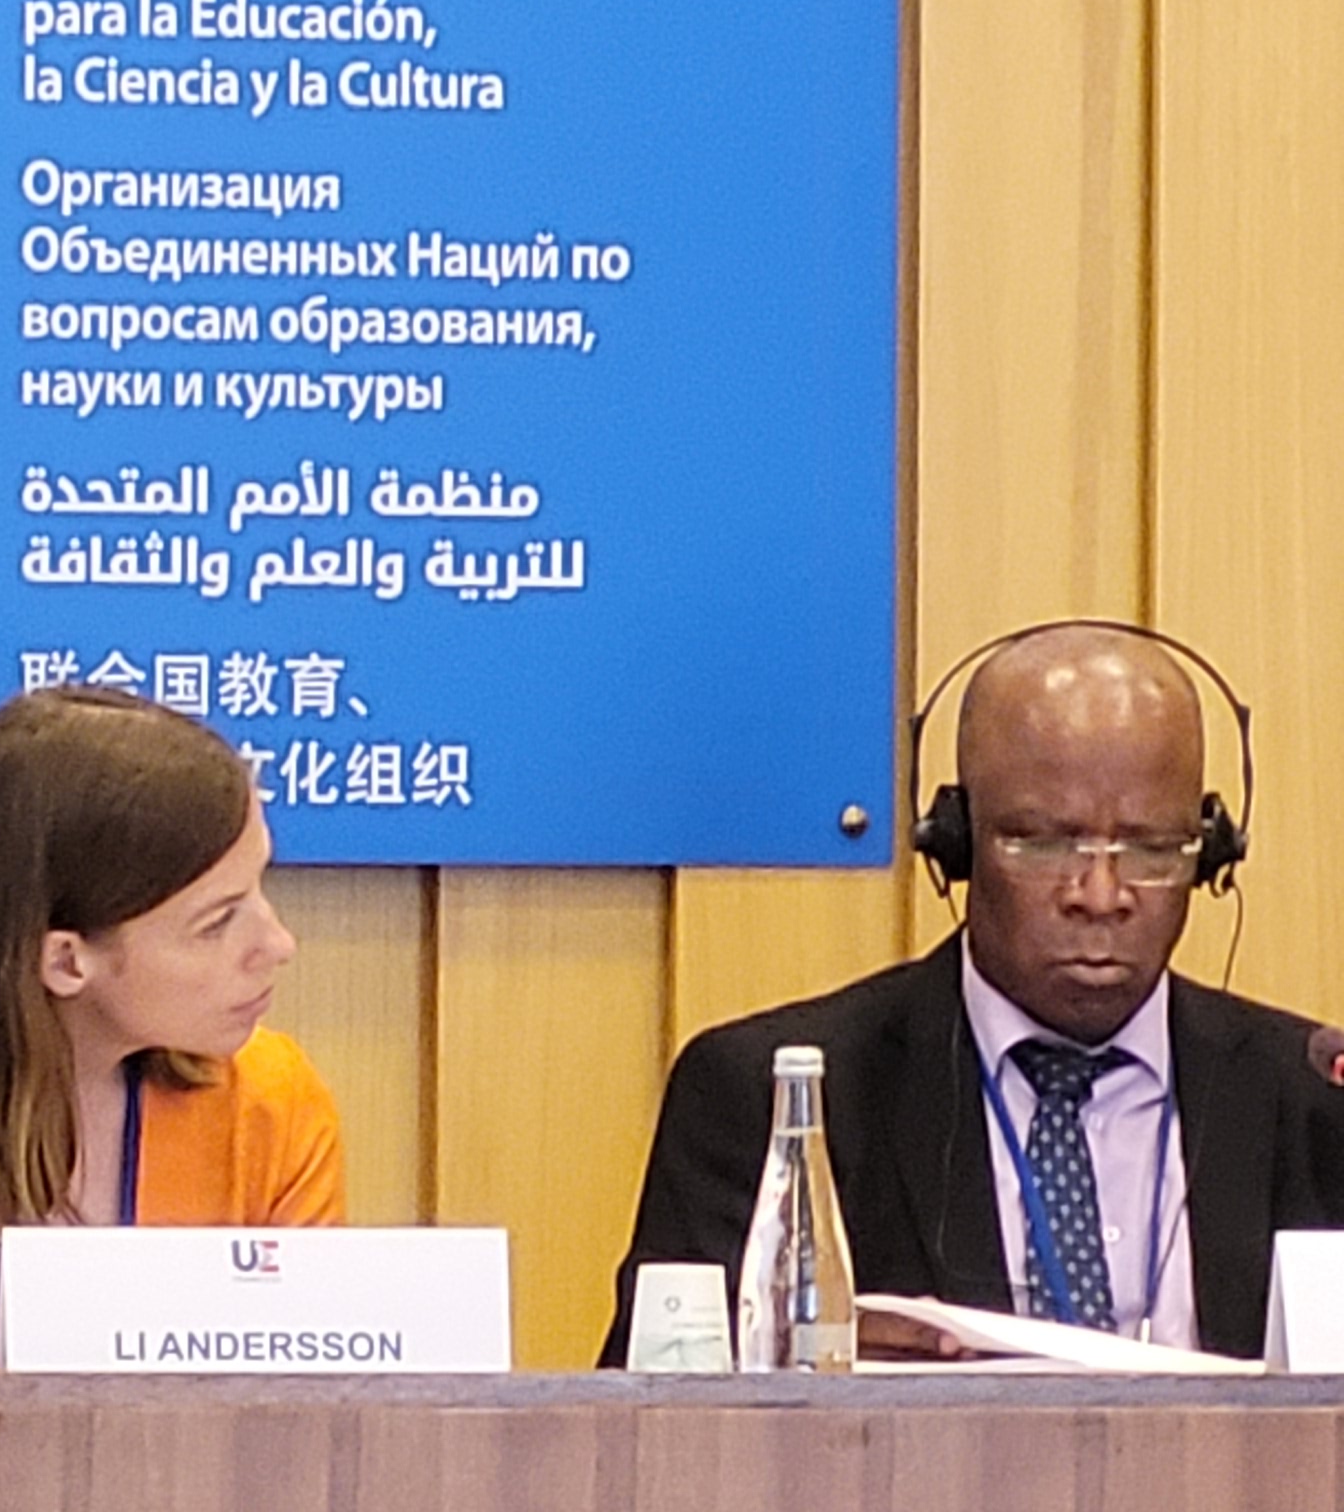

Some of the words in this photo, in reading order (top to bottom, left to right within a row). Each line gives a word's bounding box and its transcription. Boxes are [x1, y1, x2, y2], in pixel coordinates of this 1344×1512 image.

[24, 0, 126, 46] para
[24, 54, 63, 102] la
[74, 56, 239, 105] Ciencia
[250, 71, 278, 117] y
[289, 58, 327, 106] la
[339, 60, 503, 109] Cultura
[22, 159, 340, 217] Организация
[22, 225, 397, 282] Объединенных
[408, 232, 559, 287] Наций
[572, 245, 630, 280] по
[23, 304, 259, 351] вопросам
[269, 295, 595, 353] образования,
[22, 371, 161, 417] науки
[174, 372, 203, 406] и
[216, 373, 443, 421] культуры
[22, 466, 208, 514] المتحدة
[230, 460, 349, 532] الأمم
[371, 469, 539, 517] منظمة
[22, 531, 229, 597] والثقافة
[250, 538, 404, 602] والعلم
[425, 540, 584, 600] للتربية
[114, 1330, 146, 1361] LI
[157, 1331, 403, 1362] ANDERSSON
